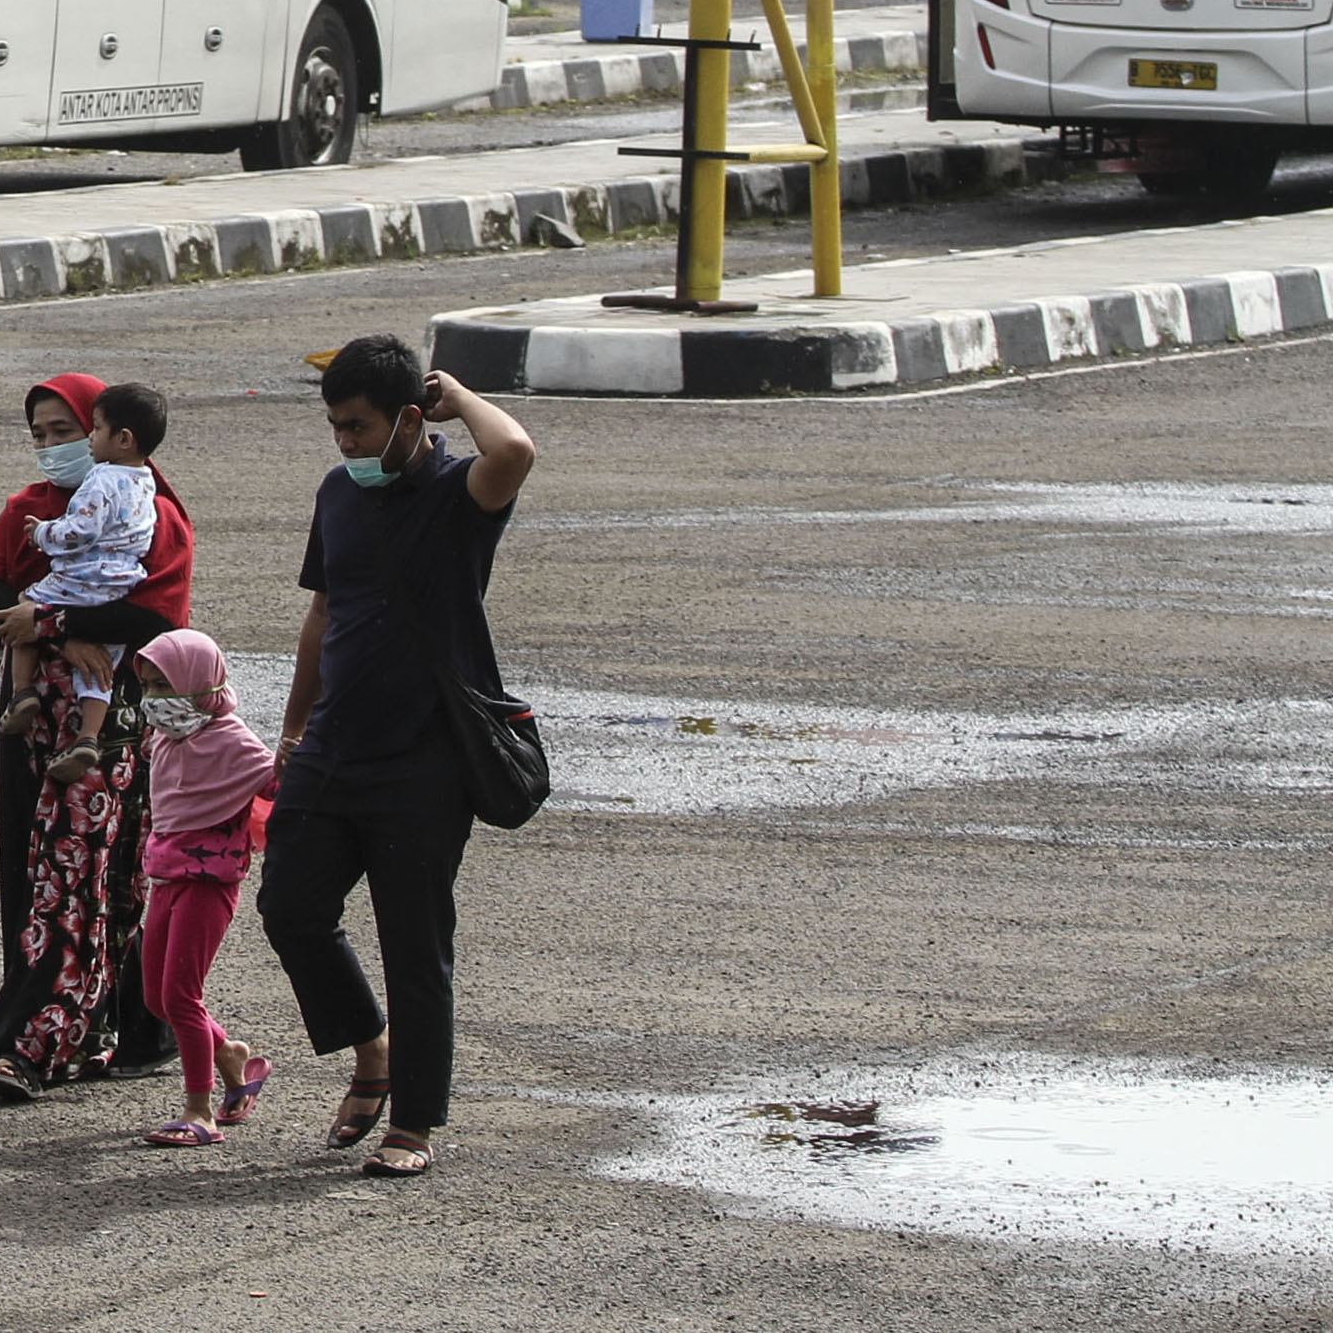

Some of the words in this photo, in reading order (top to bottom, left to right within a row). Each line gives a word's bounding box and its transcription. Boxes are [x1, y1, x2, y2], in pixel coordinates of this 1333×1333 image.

[60, 94, 95, 121] ANTAR
[96, 92, 122, 117] KOTA
[122, 89, 156, 116] ANTAR
